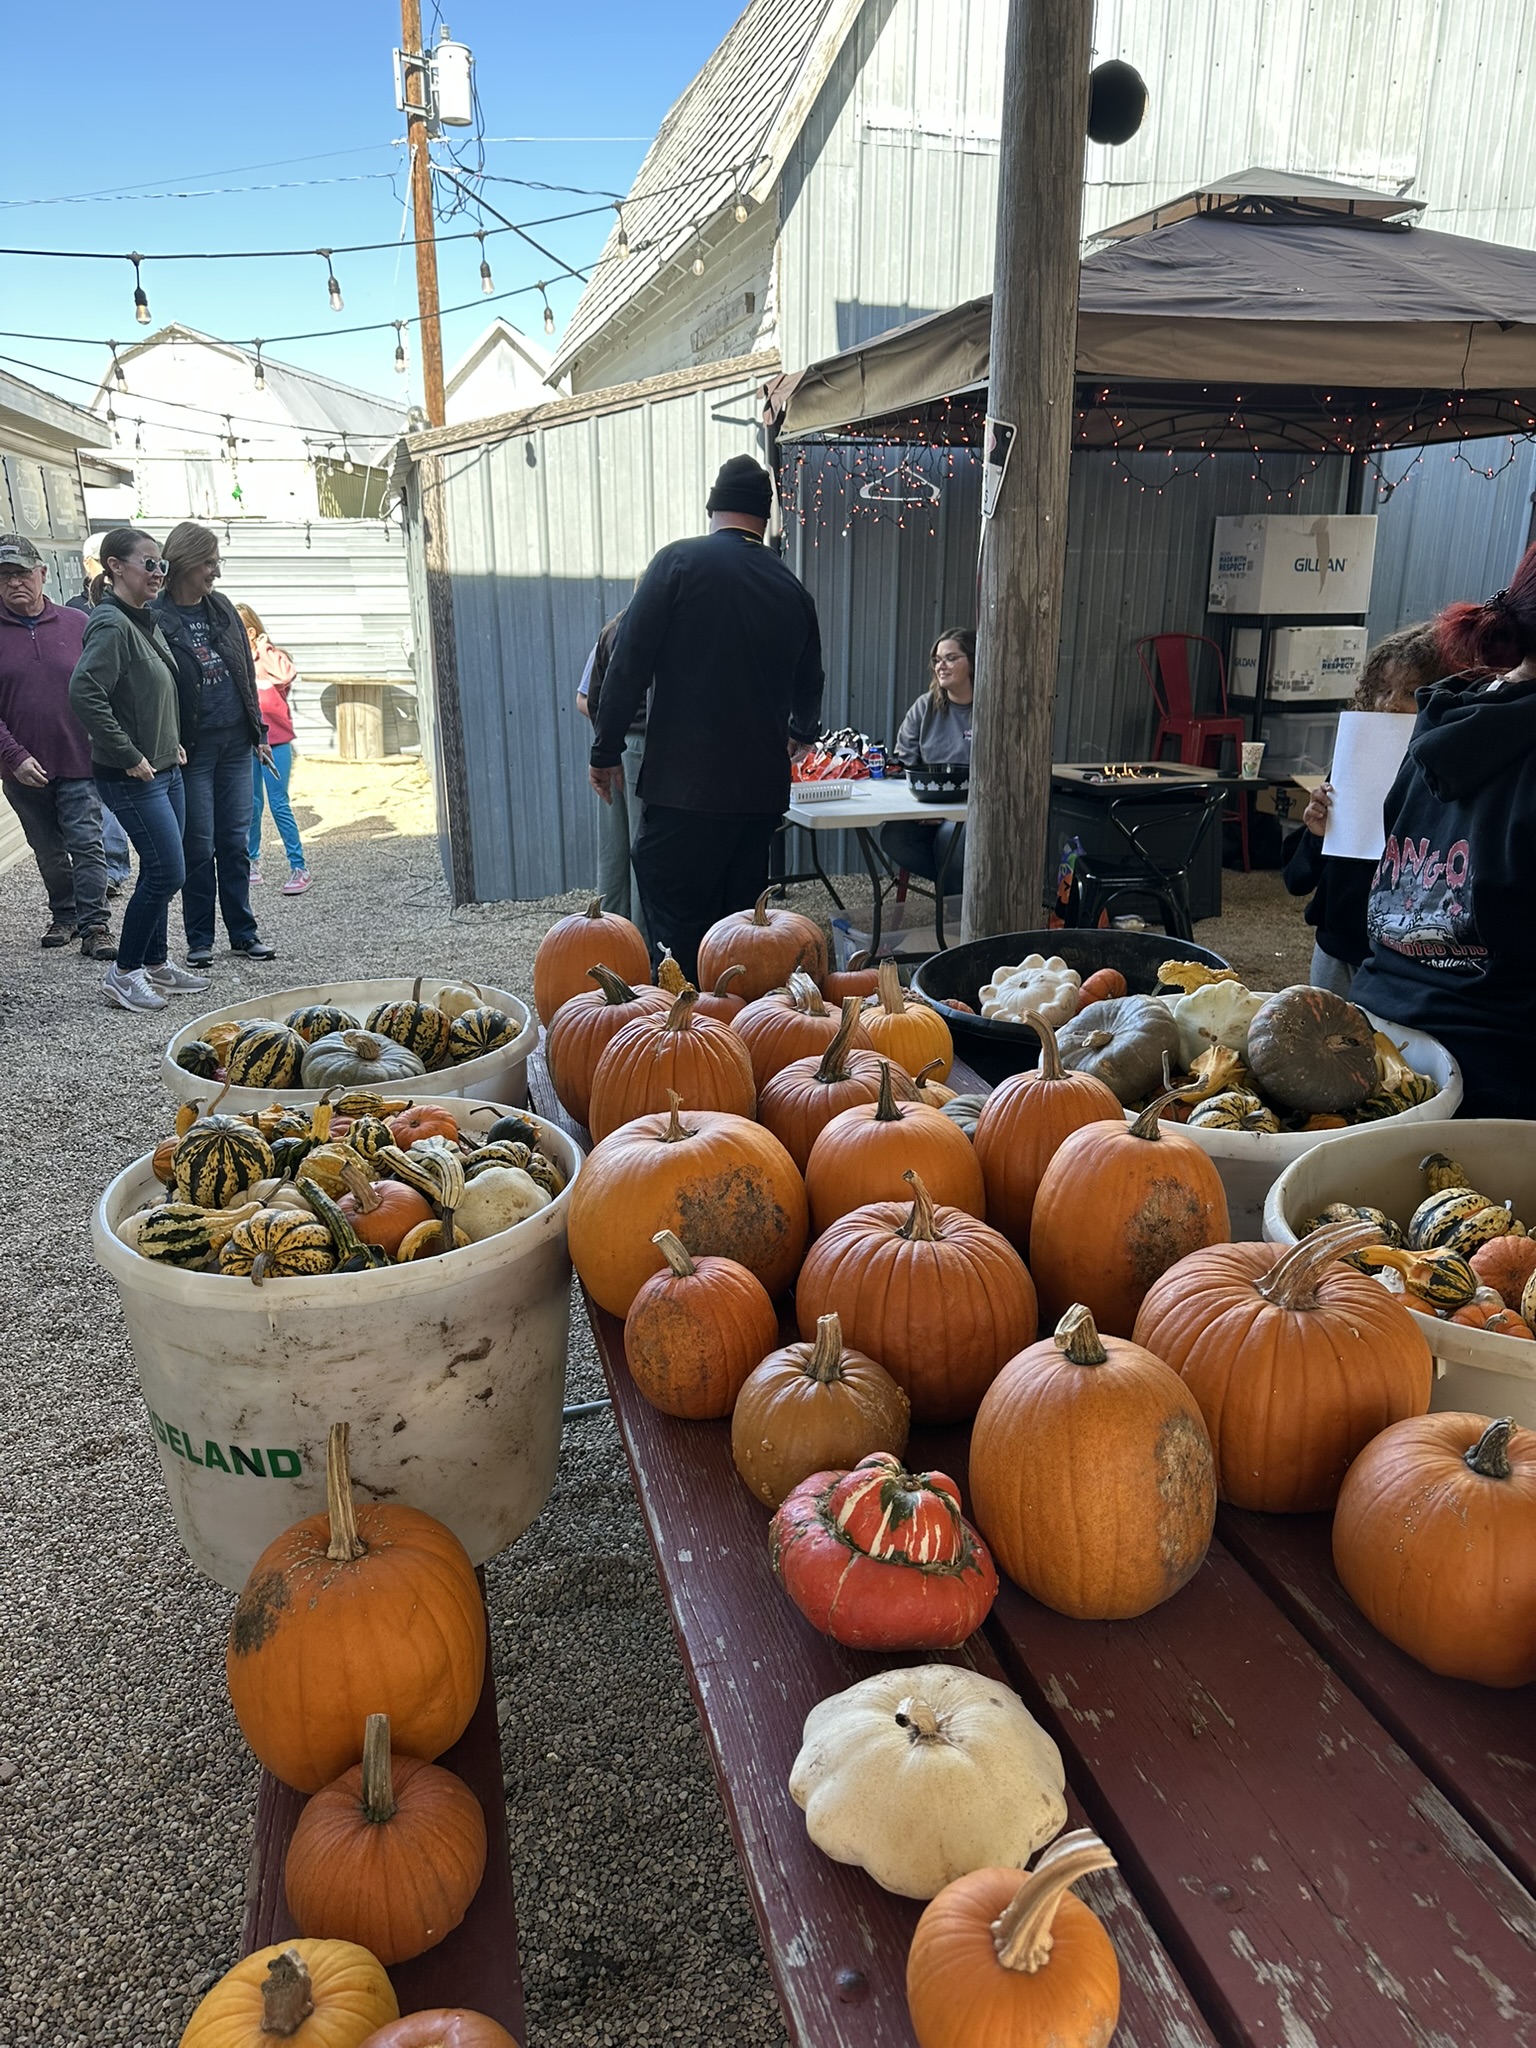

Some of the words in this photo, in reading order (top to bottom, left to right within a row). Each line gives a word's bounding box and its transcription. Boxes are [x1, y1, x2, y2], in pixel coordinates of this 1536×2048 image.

[1218, 563, 1246, 571] RESPECT
[1233, 657, 1256, 667] GILDAN
[1321, 662, 1354, 670] RESPECT
[150, 1410, 303, 1478] GELAND
